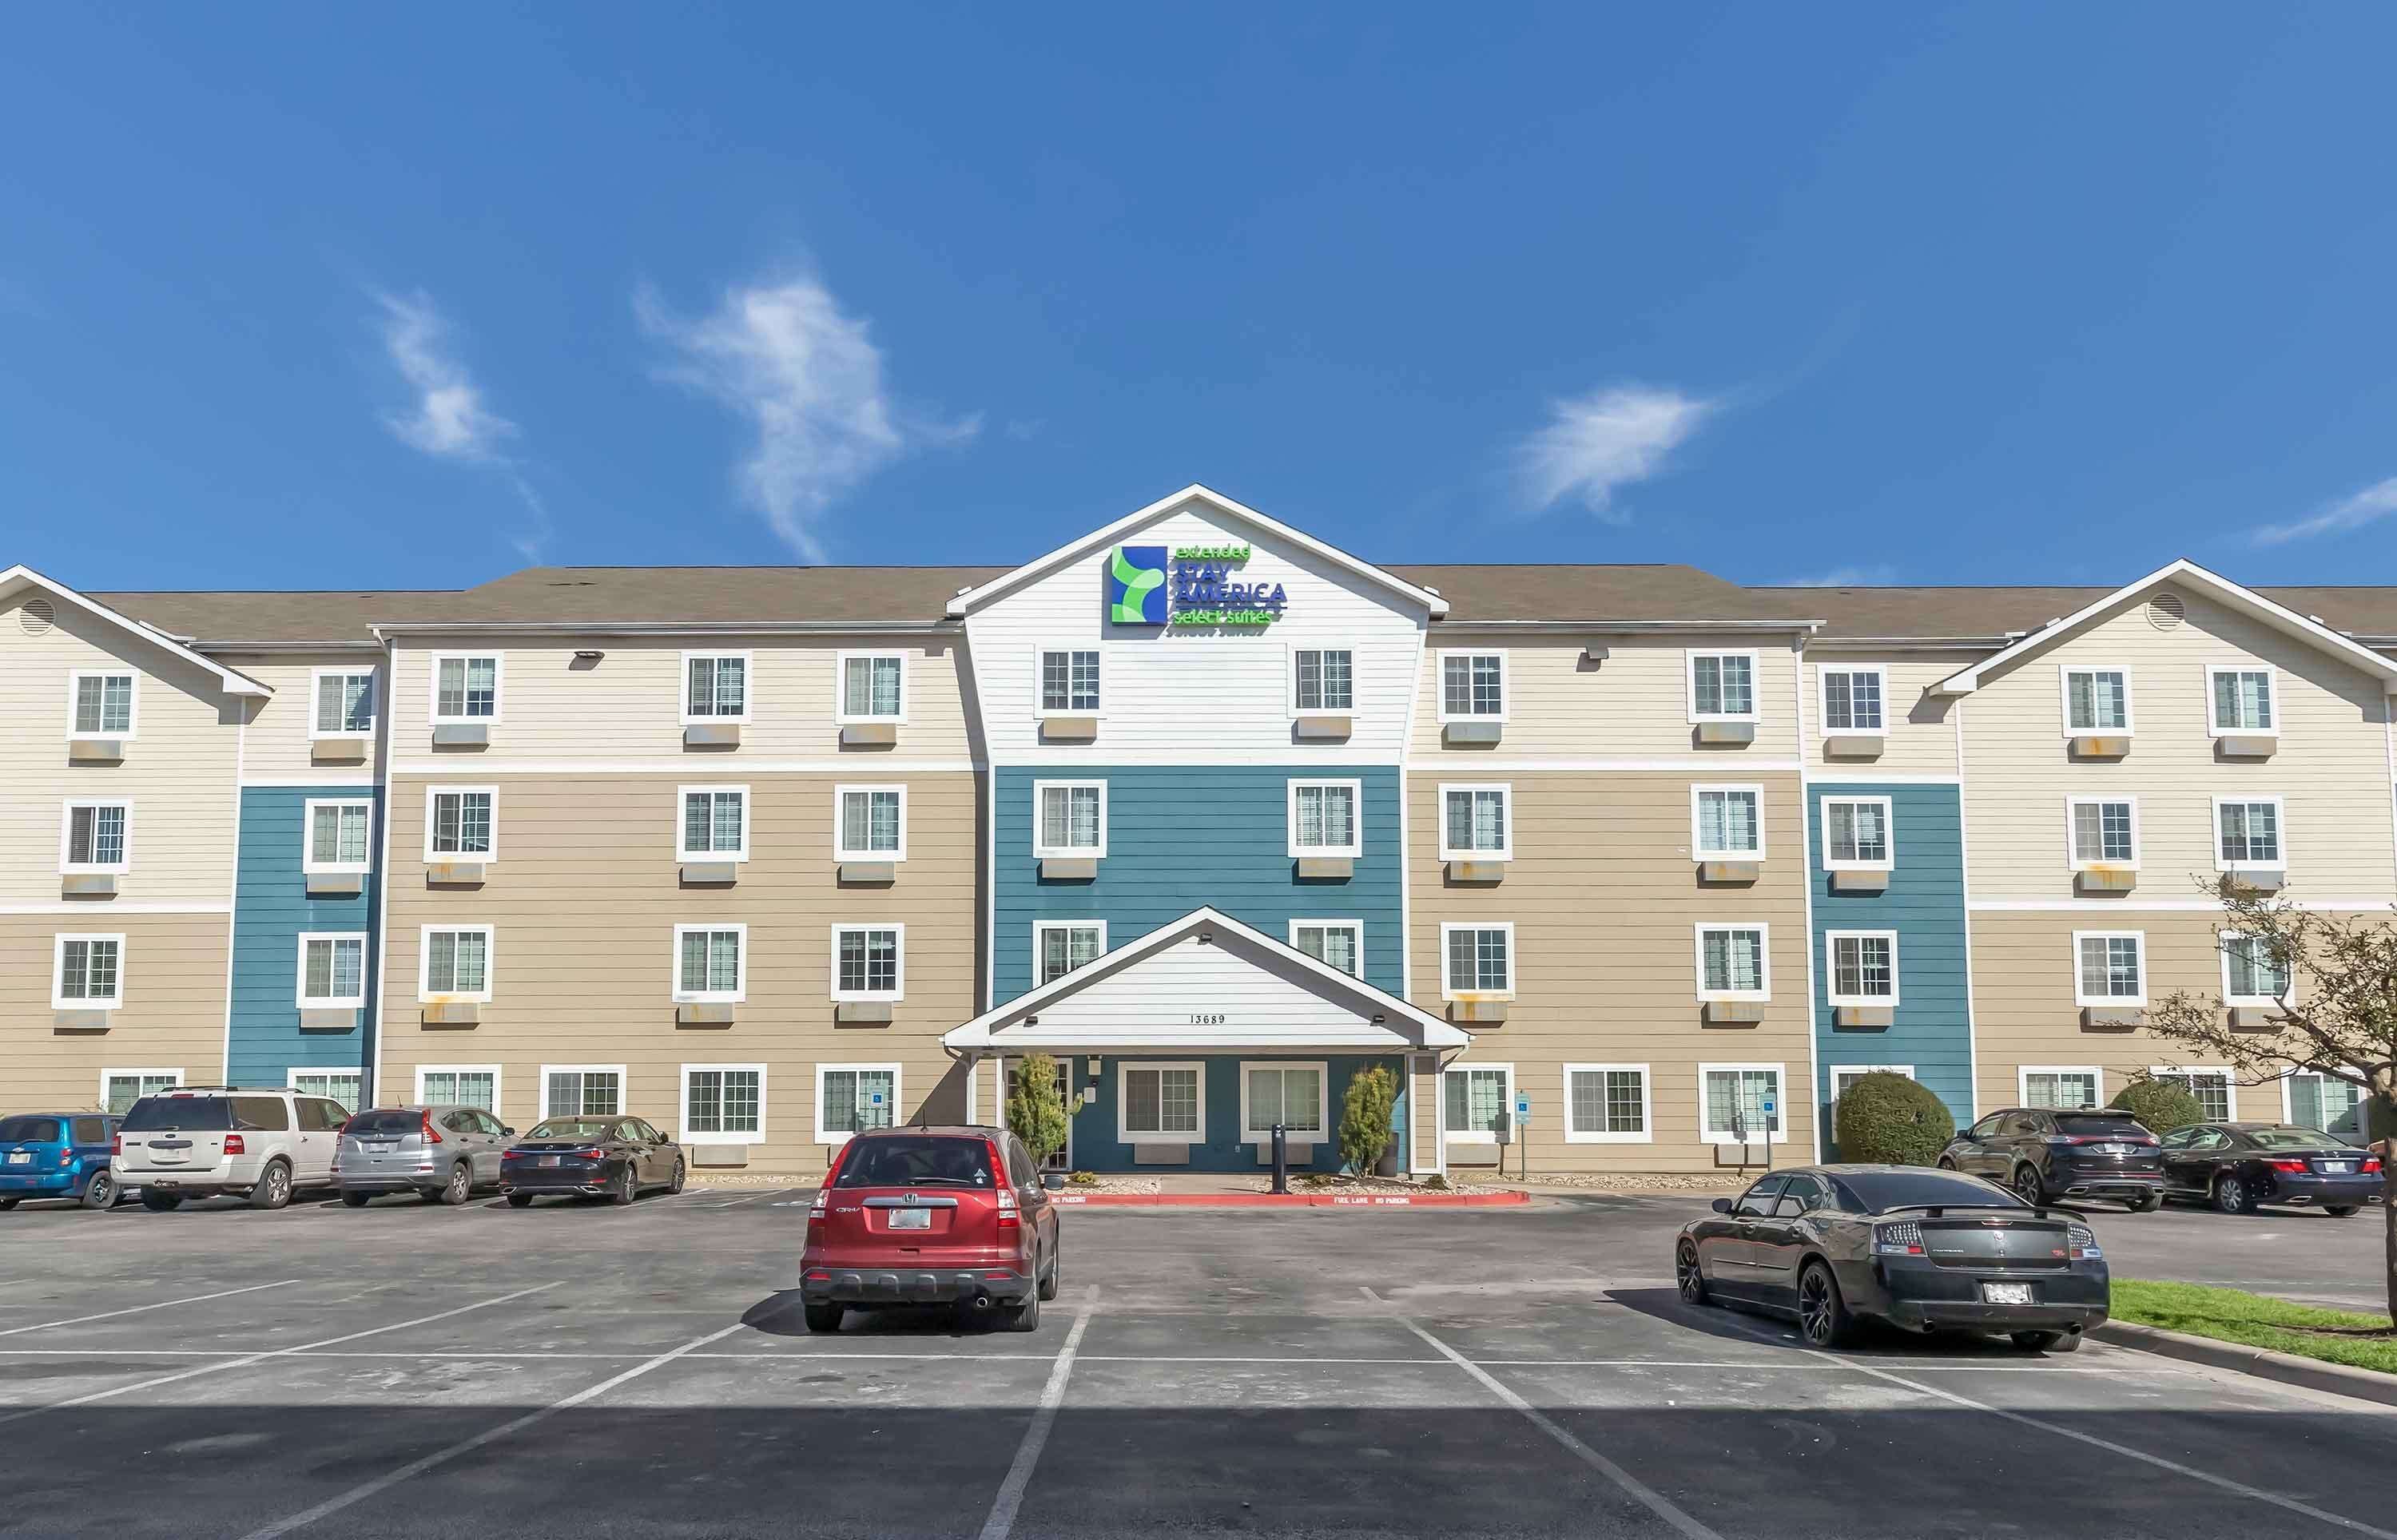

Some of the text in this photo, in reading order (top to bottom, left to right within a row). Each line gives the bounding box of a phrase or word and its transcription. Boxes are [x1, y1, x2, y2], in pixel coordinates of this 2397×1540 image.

[1176, 543, 1250, 561] extended
[1176, 562, 1232, 583] STAY
[1176, 583, 1288, 602] AMERICA
[1174, 609, 1273, 625] select suites
[1191, 1014, 1225, 1023] 13689
